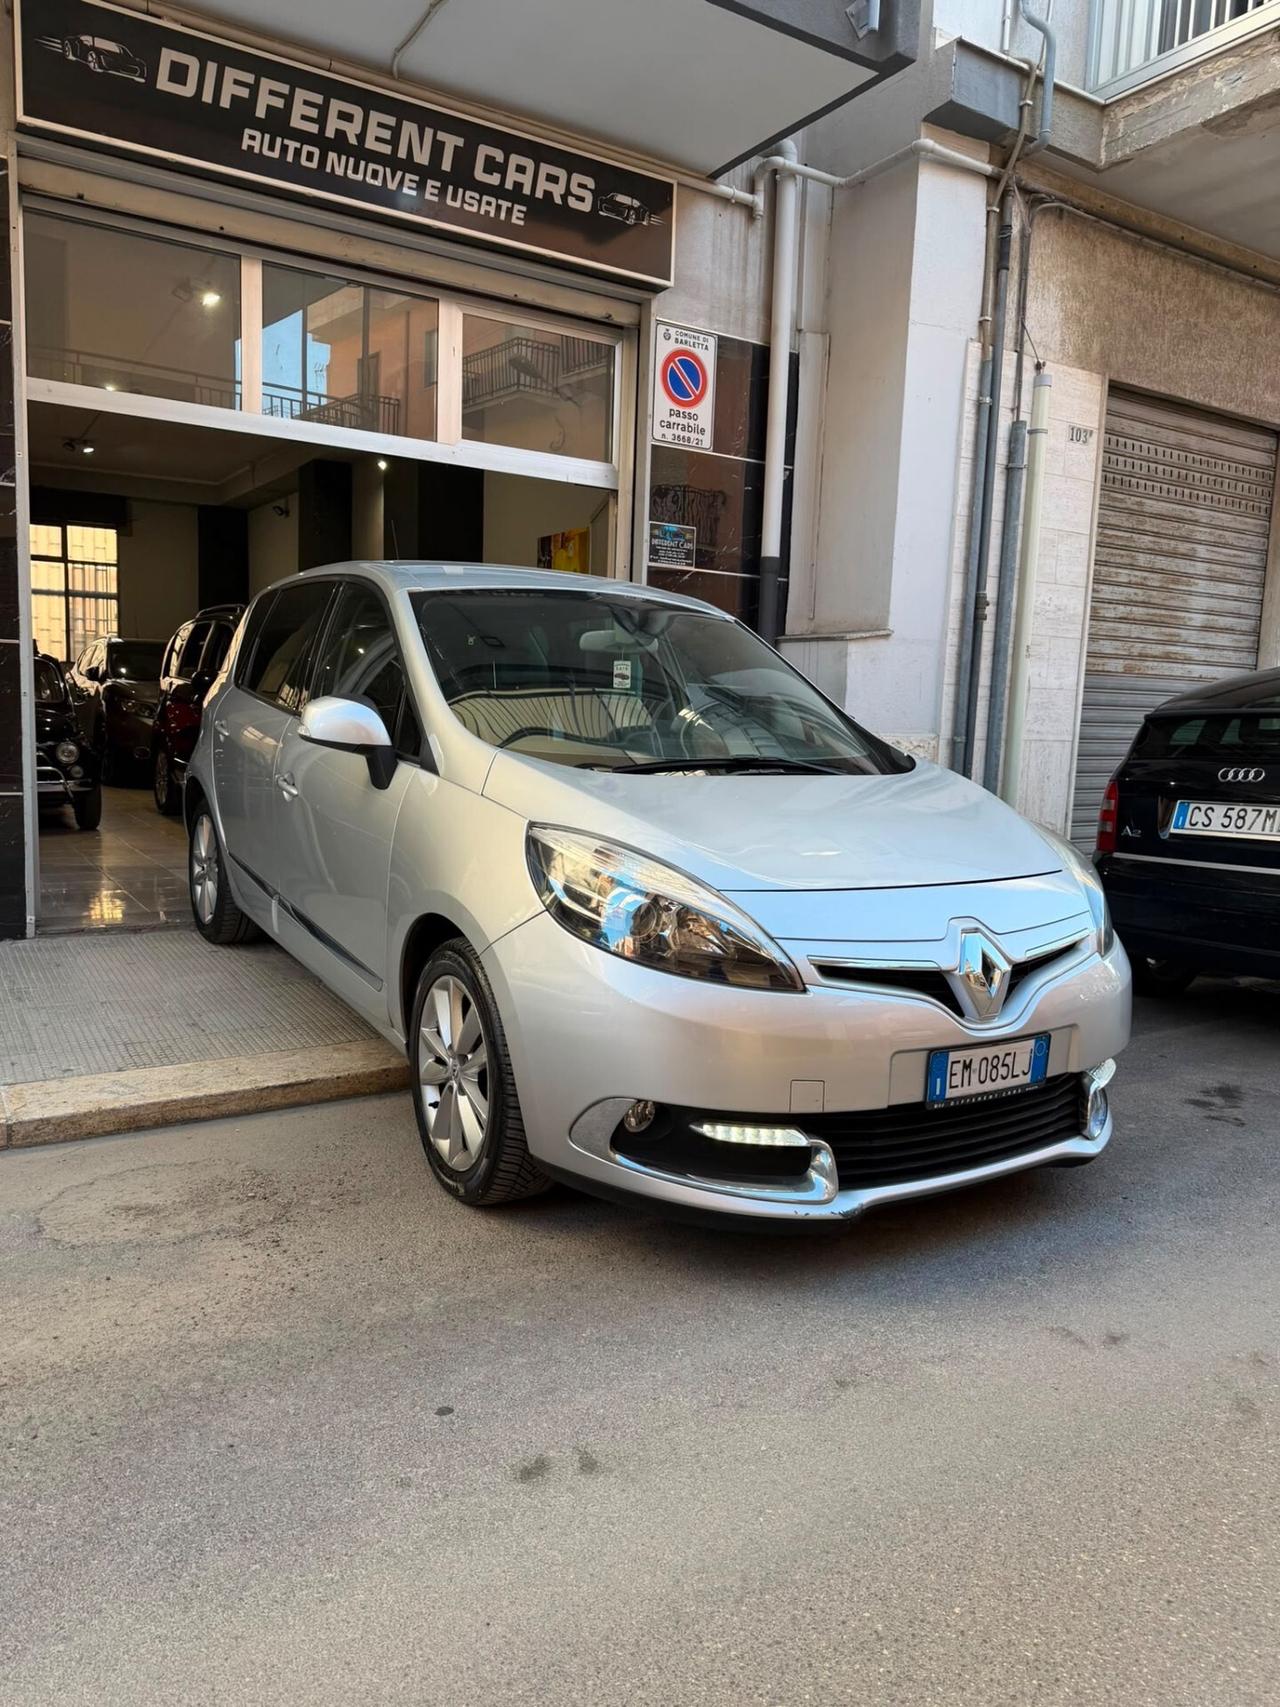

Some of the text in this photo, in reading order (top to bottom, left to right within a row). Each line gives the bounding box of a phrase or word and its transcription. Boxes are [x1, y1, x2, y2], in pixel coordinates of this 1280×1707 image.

[156, 47, 596, 213] DIFFERENT CARS
[241, 128, 527, 226] AUTO NUOVE E USATE
[674, 337, 709, 351] BARLETTA
[675, 330, 700, 342] COMUNE
[669, 408, 699, 421] passo
[660, 419, 706, 436] carrabile
[1189, 806, 1215, 827] CS
[1221, 807, 1280, 832] 587M
[1121, 825, 1142, 837] A2
[949, 1058, 973, 1089] EM
[978, 1048, 1034, 1085] 085LJ
